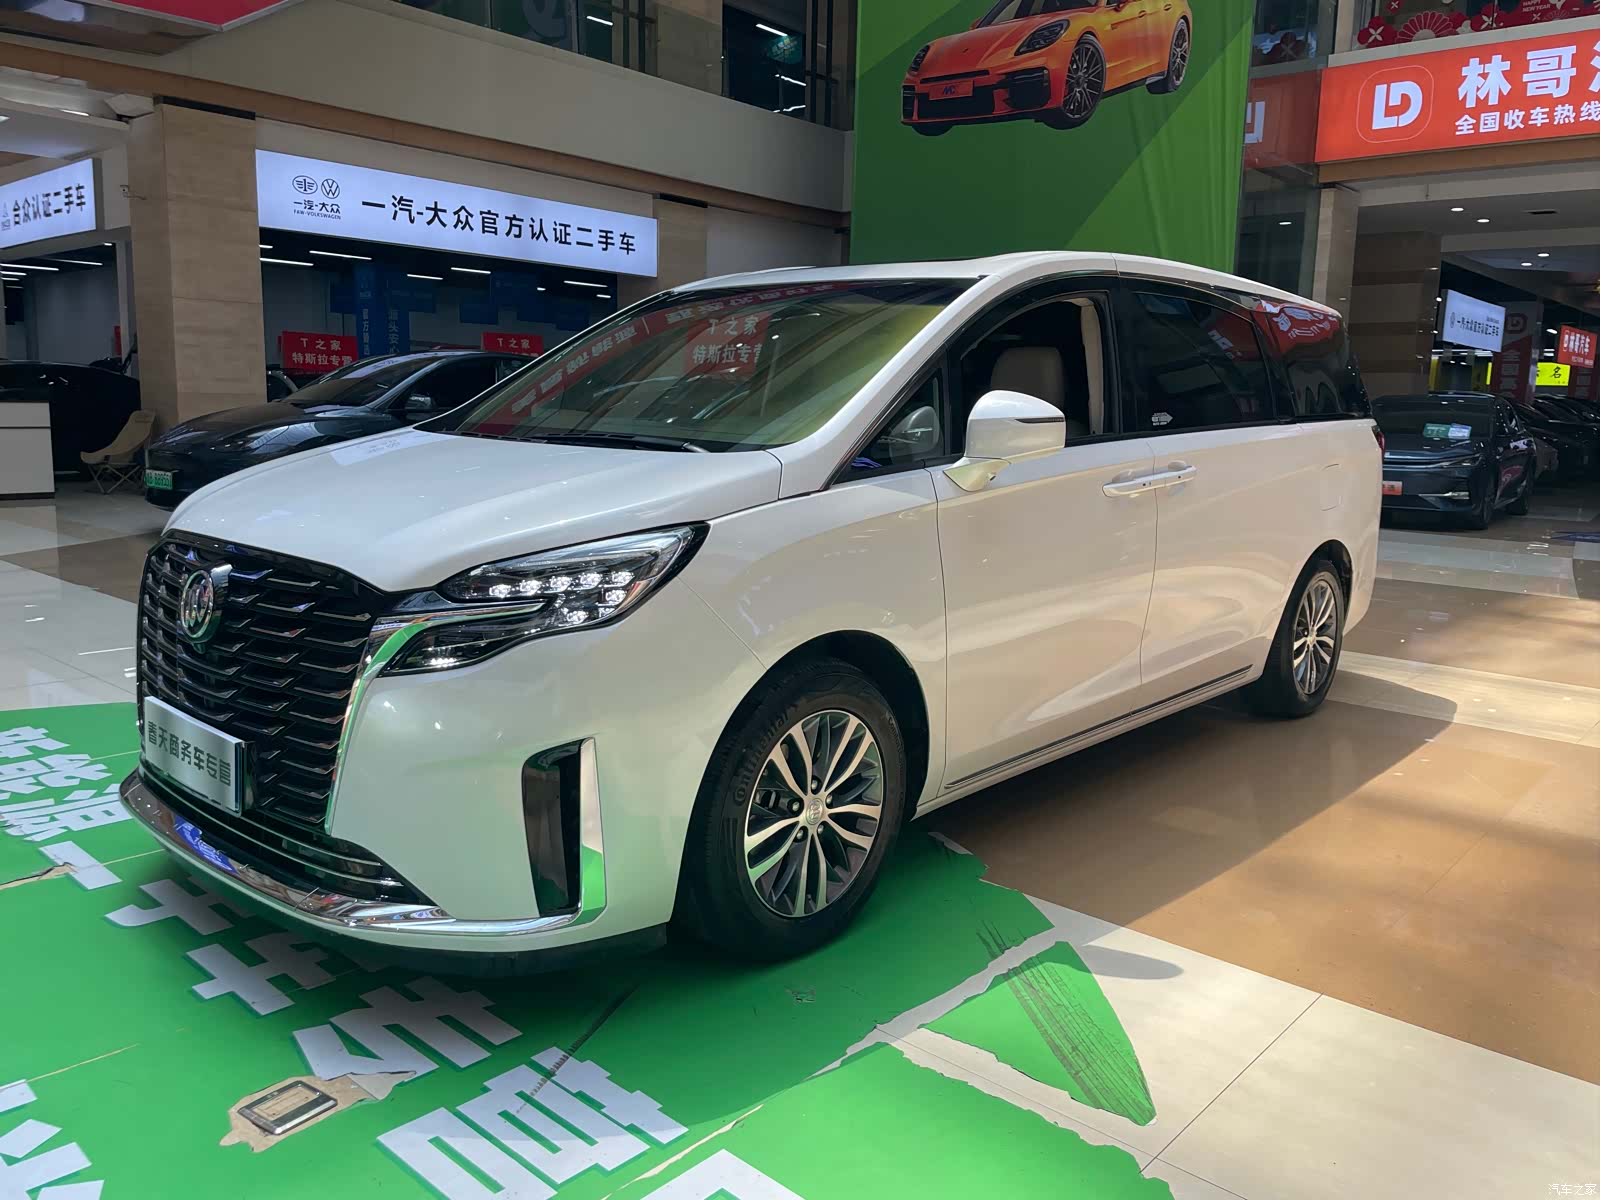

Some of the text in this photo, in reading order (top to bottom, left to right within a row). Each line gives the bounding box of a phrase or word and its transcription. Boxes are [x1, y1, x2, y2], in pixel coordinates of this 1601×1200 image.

[1455, 101, 1600, 136] 全国收车热线
[293, 199, 341, 214] 一汽-大众
[293, 209, 341, 220] FAW-VOLKSWAGEN
[361, 194, 636, 255] 一汽-大众官方认证二手车
[147, 720, 231, 787] 春天商务车专营
